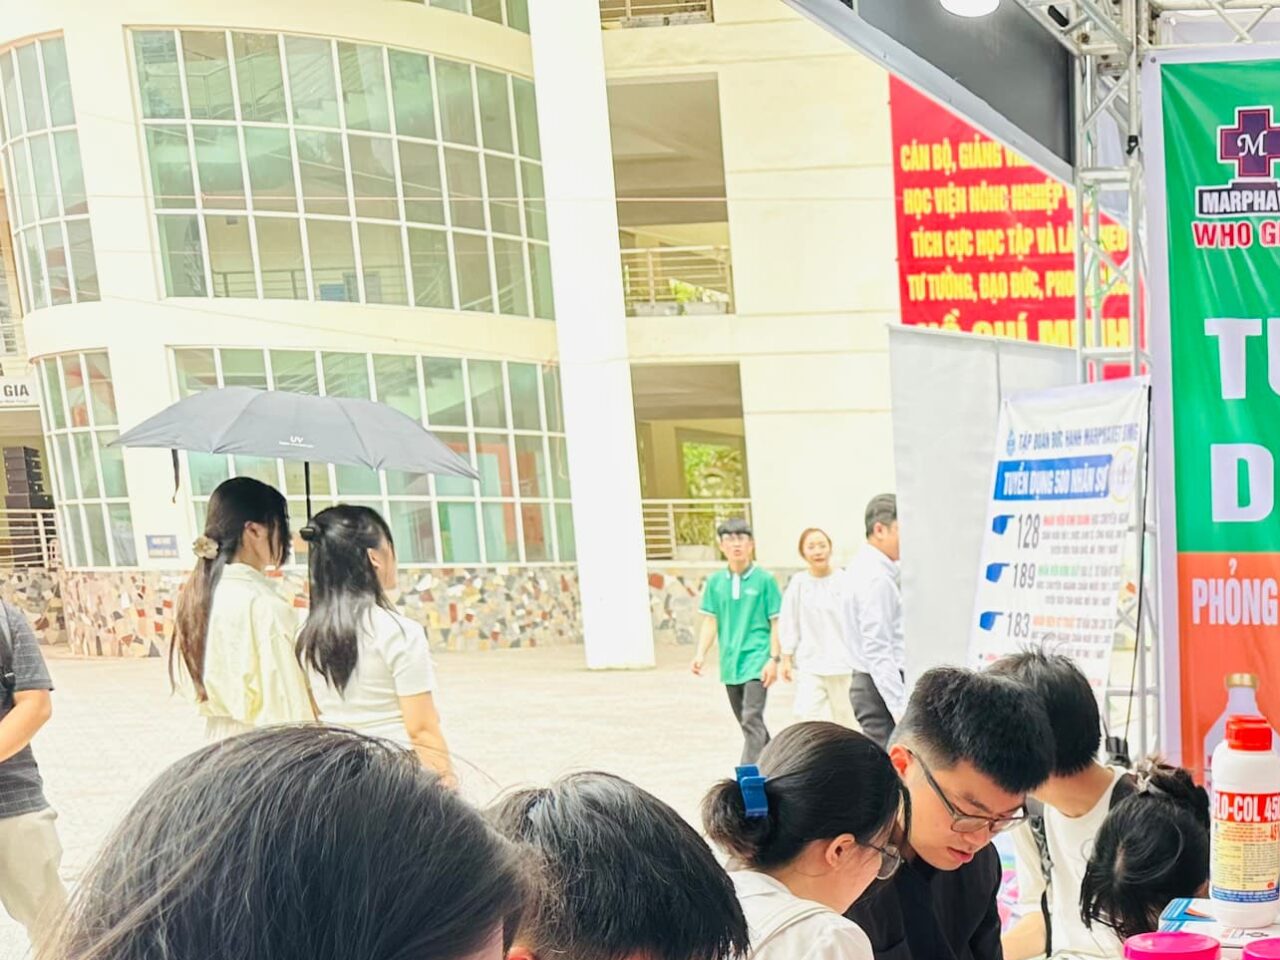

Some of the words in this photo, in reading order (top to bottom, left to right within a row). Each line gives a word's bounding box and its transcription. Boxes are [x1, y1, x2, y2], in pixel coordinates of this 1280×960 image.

[903, 187, 931, 221] HỌC
[934, 181, 967, 219] VIỆN
[911, 226, 943, 258] TÍCH
[976, 229, 1005, 262] HỌC
[1007, 222, 1034, 262] TẬP
[1192, 221, 1251, 248] WHO
[979, 272, 1008, 305] ĐẠO
[3, 384, 30, 397] GIA
[1017, 513, 1041, 549] 128
[1012, 563, 1036, 589] 189
[1192, 558, 1278, 625] PHỎNG
[1007, 612, 1030, 638] 183
